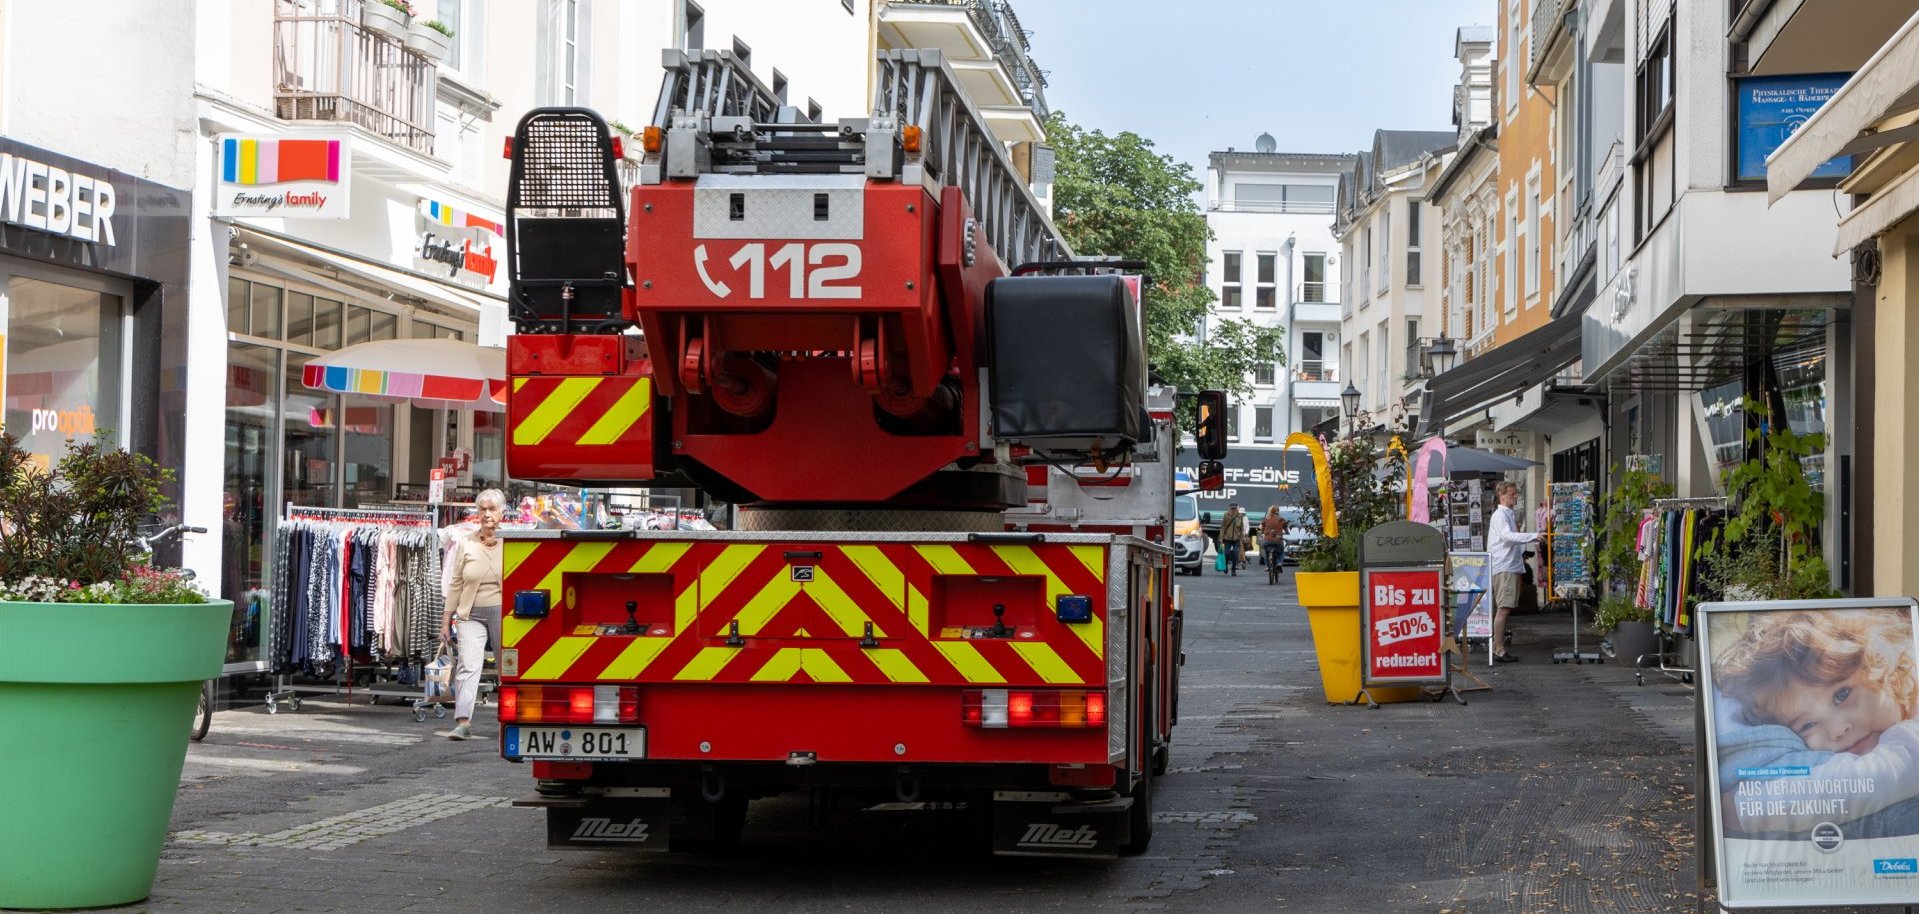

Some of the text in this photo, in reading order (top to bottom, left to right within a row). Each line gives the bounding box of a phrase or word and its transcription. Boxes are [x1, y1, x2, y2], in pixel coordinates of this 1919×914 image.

[0, 153, 116, 246] WEBER
[233, 190, 327, 210] Ernsting's family
[729, 243, 862, 298] 112
[1480, 432, 1522, 445] BONITA
[1374, 585, 1435, 606] Bis zu
[1381, 615, 1428, 639] -50%
[1376, 652, 1437, 668] reduziert
[527, 731, 628, 754] AW 801
[1738, 778, 1875, 797] AUS VERANTWORTUNG
[1740, 798, 1849, 816] FÜR DIE ZUKUNFT.
[570, 818, 649, 842] Metz
[1016, 823, 1098, 848] Metz
[1879, 860, 1911, 871] Debeka
